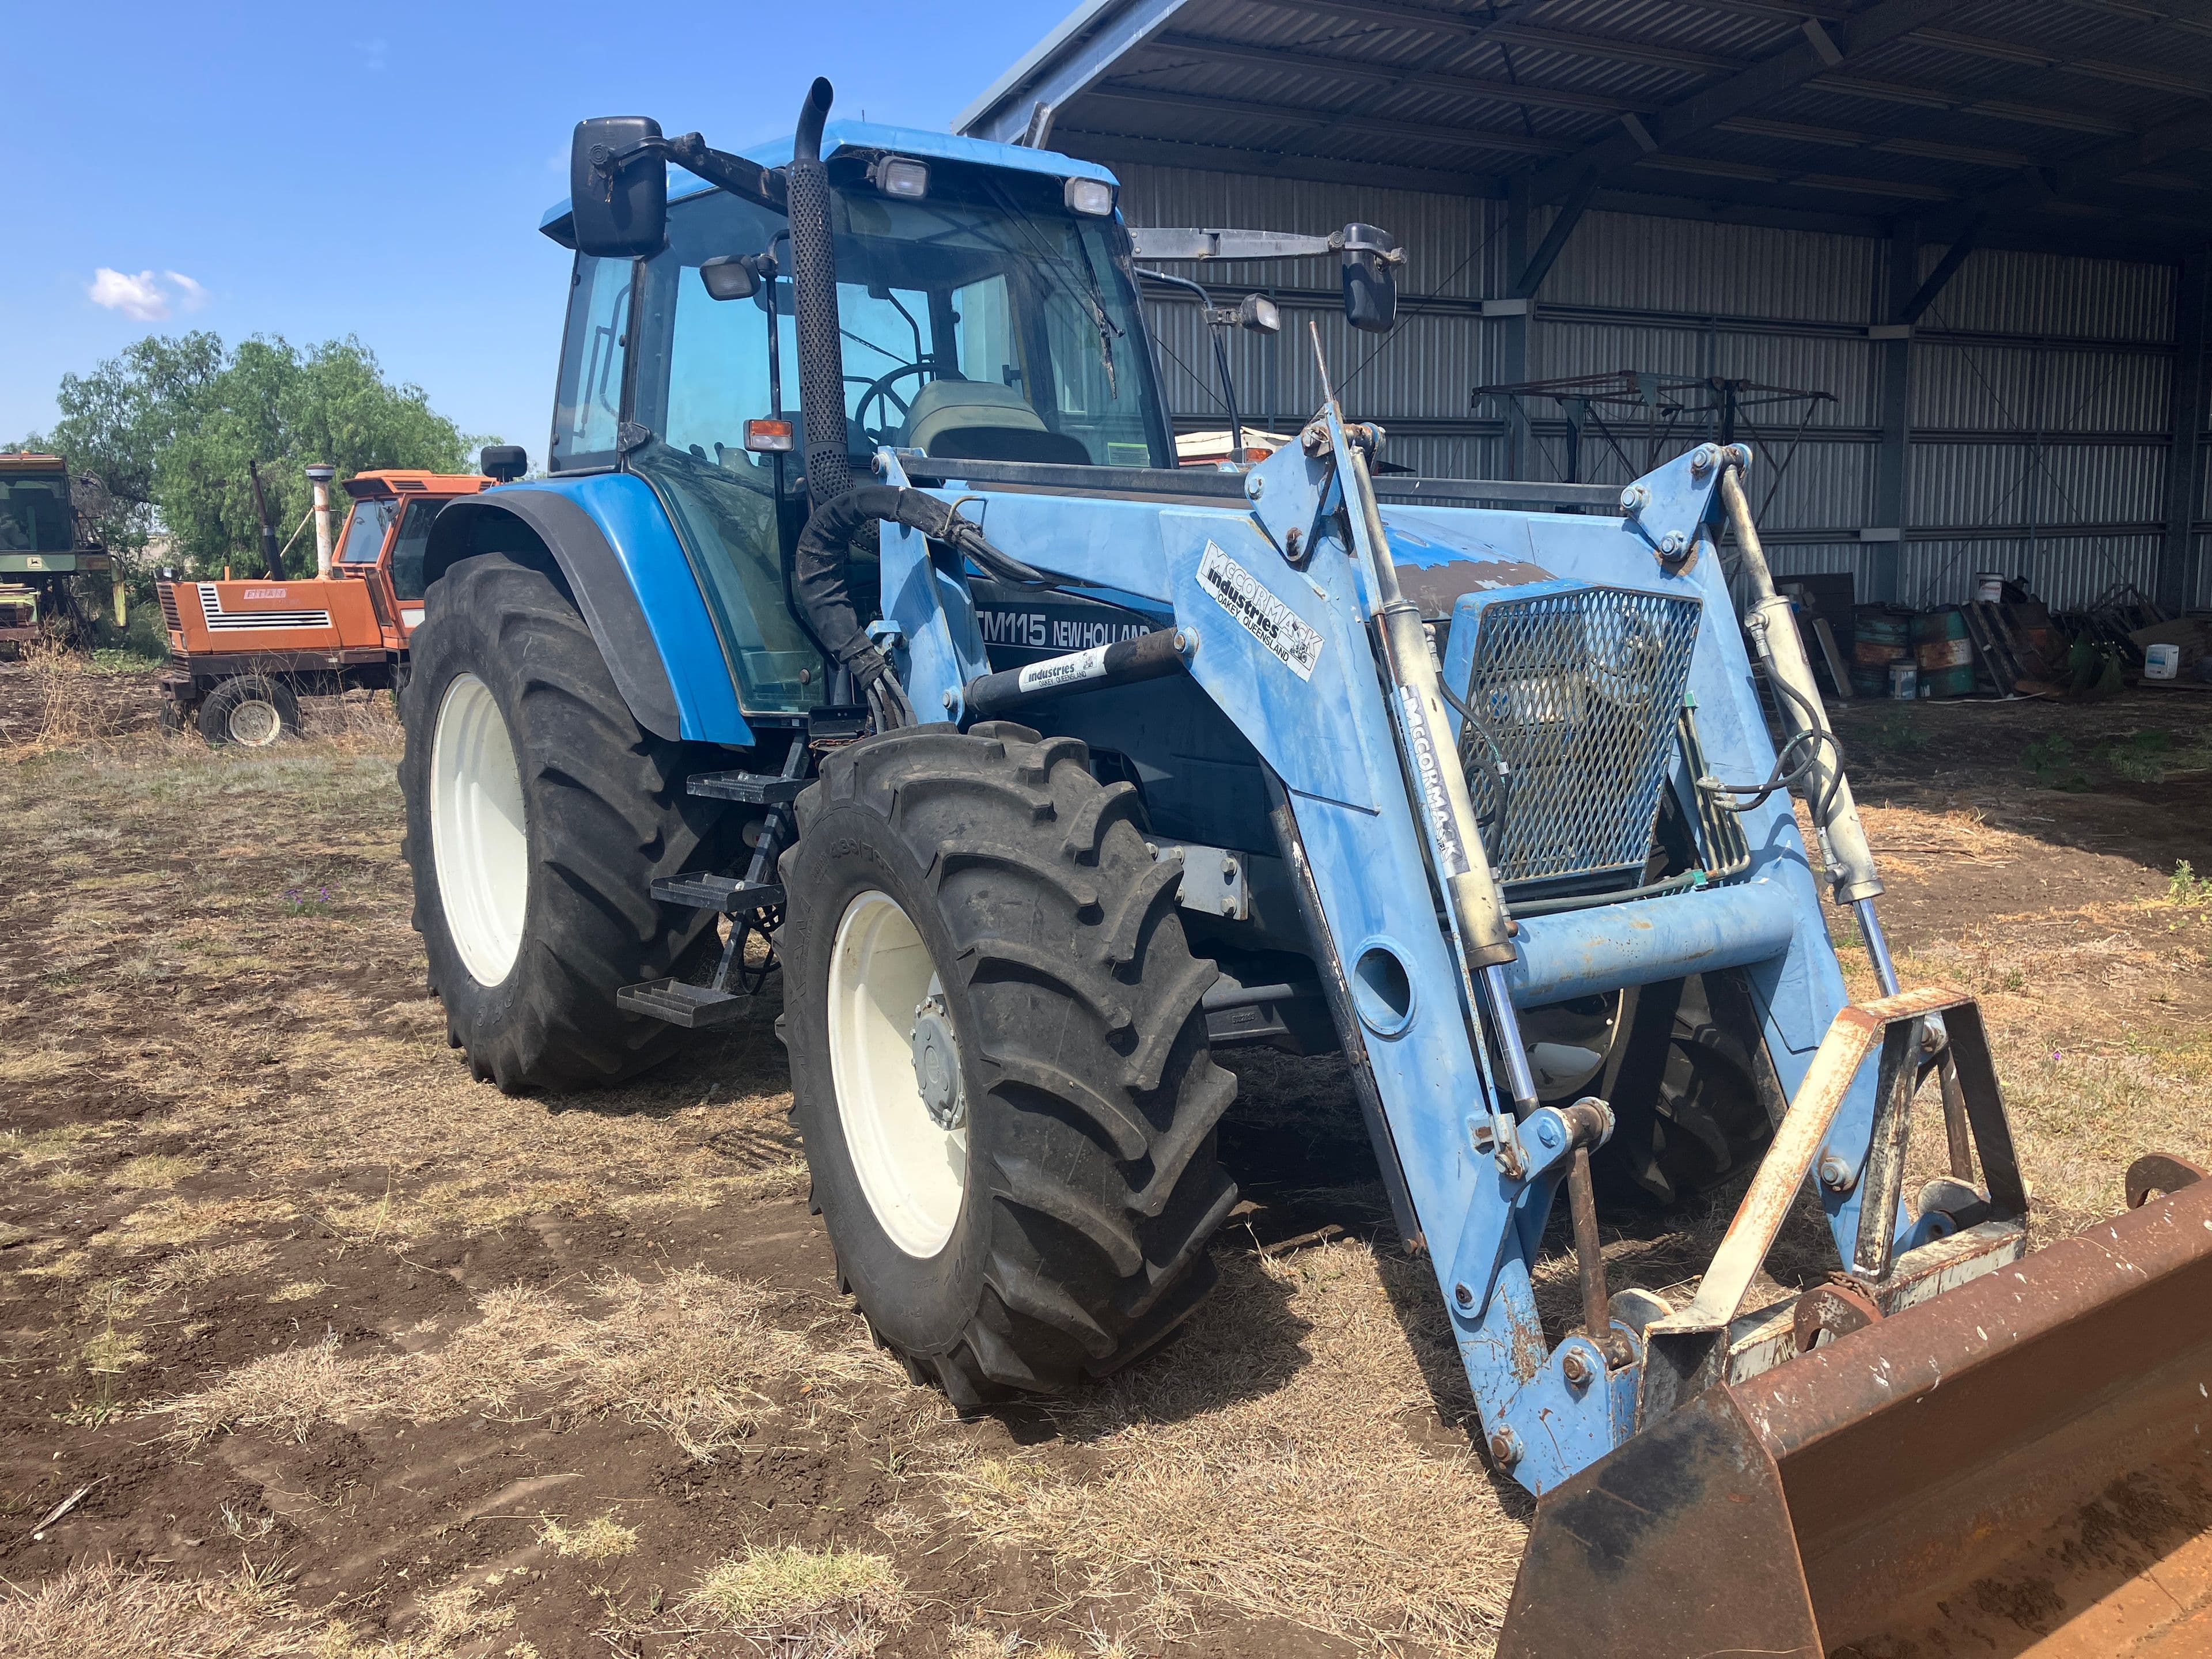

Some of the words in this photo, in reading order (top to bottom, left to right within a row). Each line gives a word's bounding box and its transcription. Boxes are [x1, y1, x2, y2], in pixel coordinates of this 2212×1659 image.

[246, 589, 285, 598] FIAT
[1207, 567, 1279, 640] industries
[1053, 620, 1082, 647] NEW
[1243, 616, 1290, 662] QUEENSLAND
[1029, 663, 1075, 683] industries
[1055, 671, 1087, 684] QUEENSLAND
